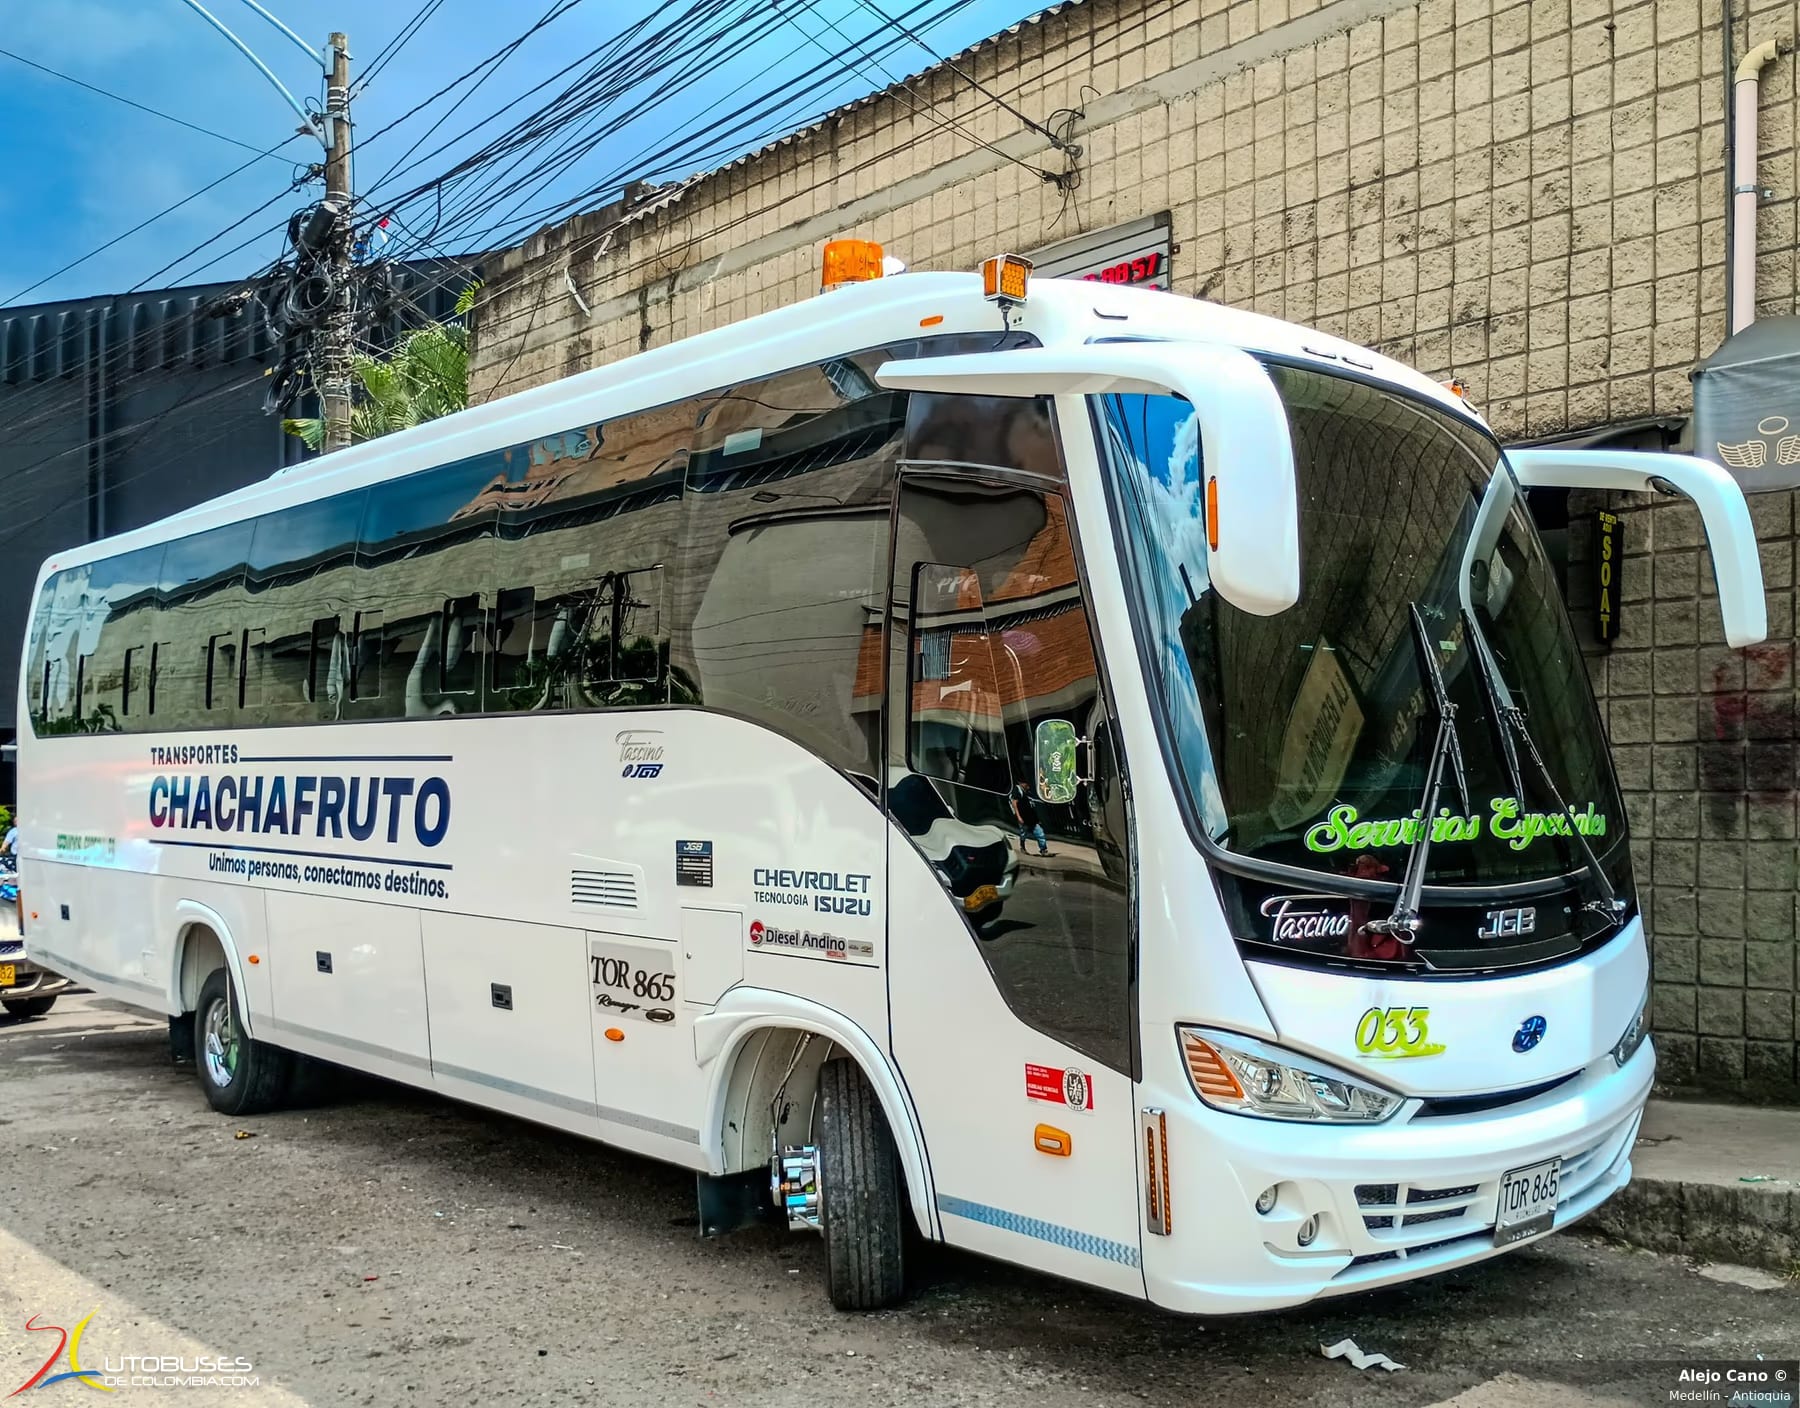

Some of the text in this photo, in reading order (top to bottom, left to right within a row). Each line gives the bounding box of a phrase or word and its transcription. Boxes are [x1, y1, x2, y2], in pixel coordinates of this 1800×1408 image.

[1131, 252, 1162, 283] 57
[1600, 535, 1612, 639] SOAT
[151, 744, 238, 765] TRANSPORTES
[615, 729, 664, 762] Fascino
[149, 775, 451, 847] CHACHAFRUTO
[1489, 797, 1606, 851] Especiales
[209, 852, 449, 899] Unimos personas, conectamos destinos.
[753, 869, 871, 893] CHEVROLET
[754, 891, 871, 916] TECNOLOGIA ISUZU
[1260, 894, 1352, 942] Fascino
[1478, 906, 1536, 939] JGB
[766, 929, 846, 951] Diesel Andino
[591, 955, 675, 1001] TOR 865
[1355, 1006, 1436, 1057] 033
[1504, 1168, 1558, 1213] TOR 865
